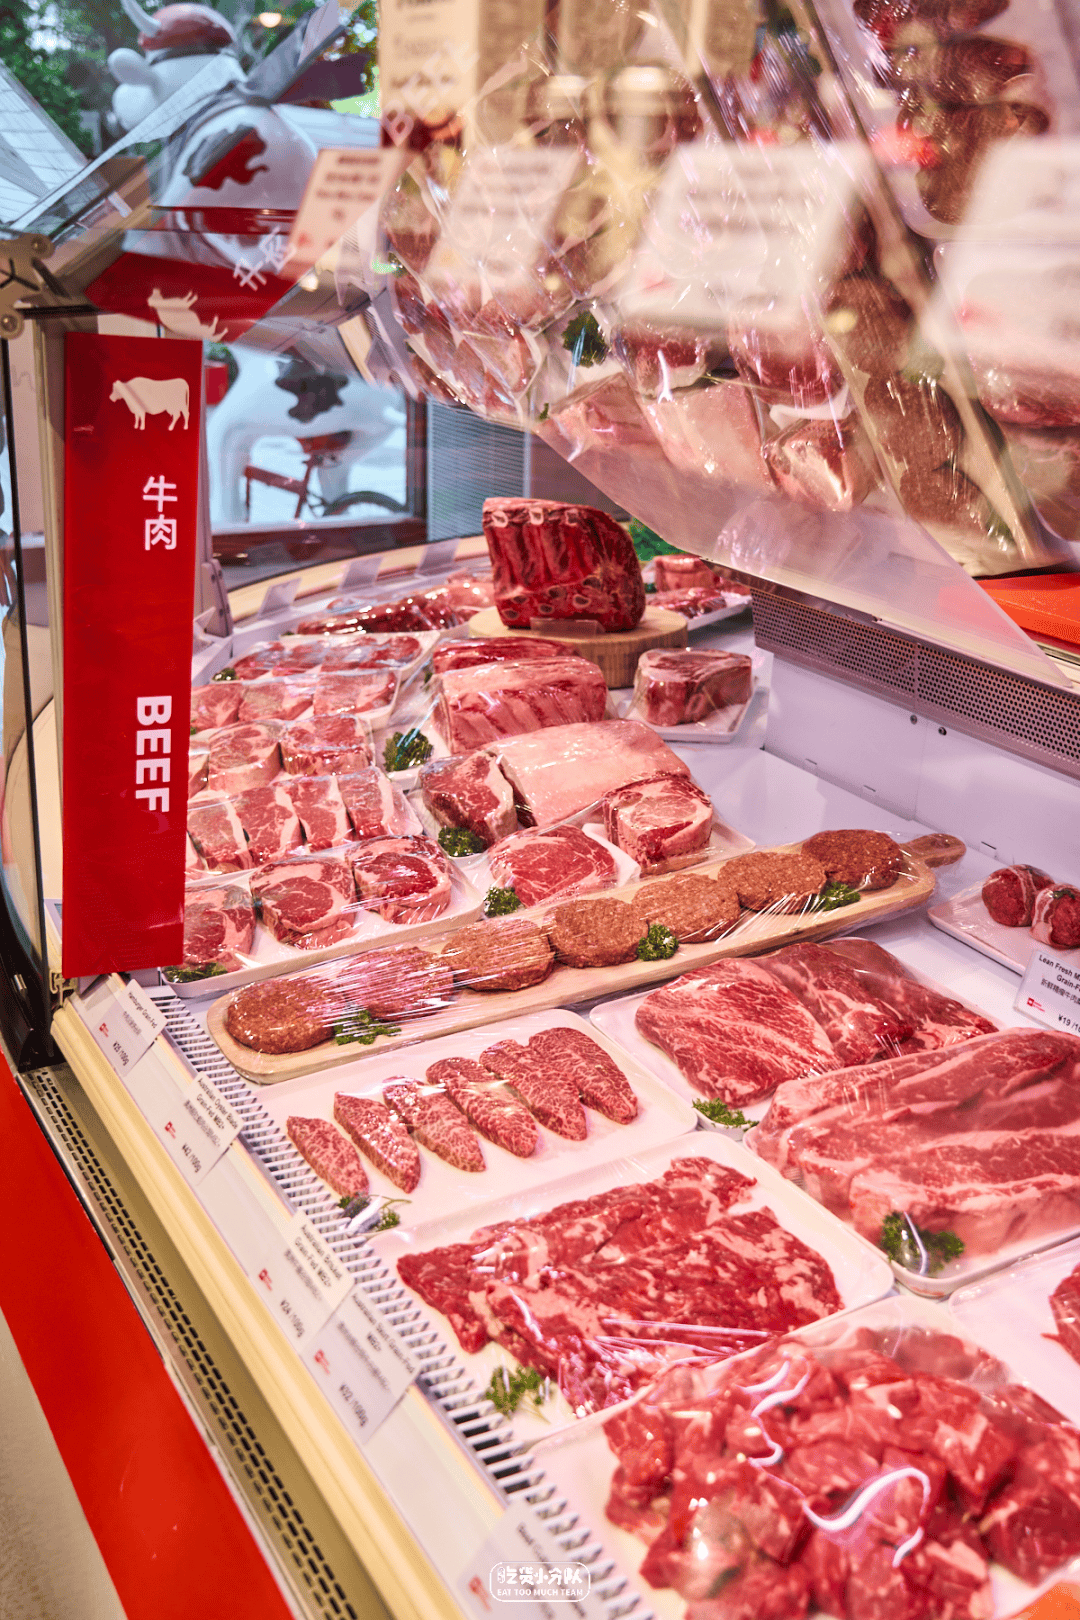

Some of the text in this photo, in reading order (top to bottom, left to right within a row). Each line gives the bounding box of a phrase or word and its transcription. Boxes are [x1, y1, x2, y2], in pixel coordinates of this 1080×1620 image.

[142, 475, 178, 551] 牛肉
[135, 695, 172, 813] BEEF
[1039, 955, 1054, 967] Lean
[1054, 962, 1073, 977] Fresh
[1058, 1013, 1071, 1027] ¥19
[196, 1093, 215, 1118] Grain-Fed
[198, 1077, 217, 1101] Australian
[214, 1098, 229, 1116] Oyster
